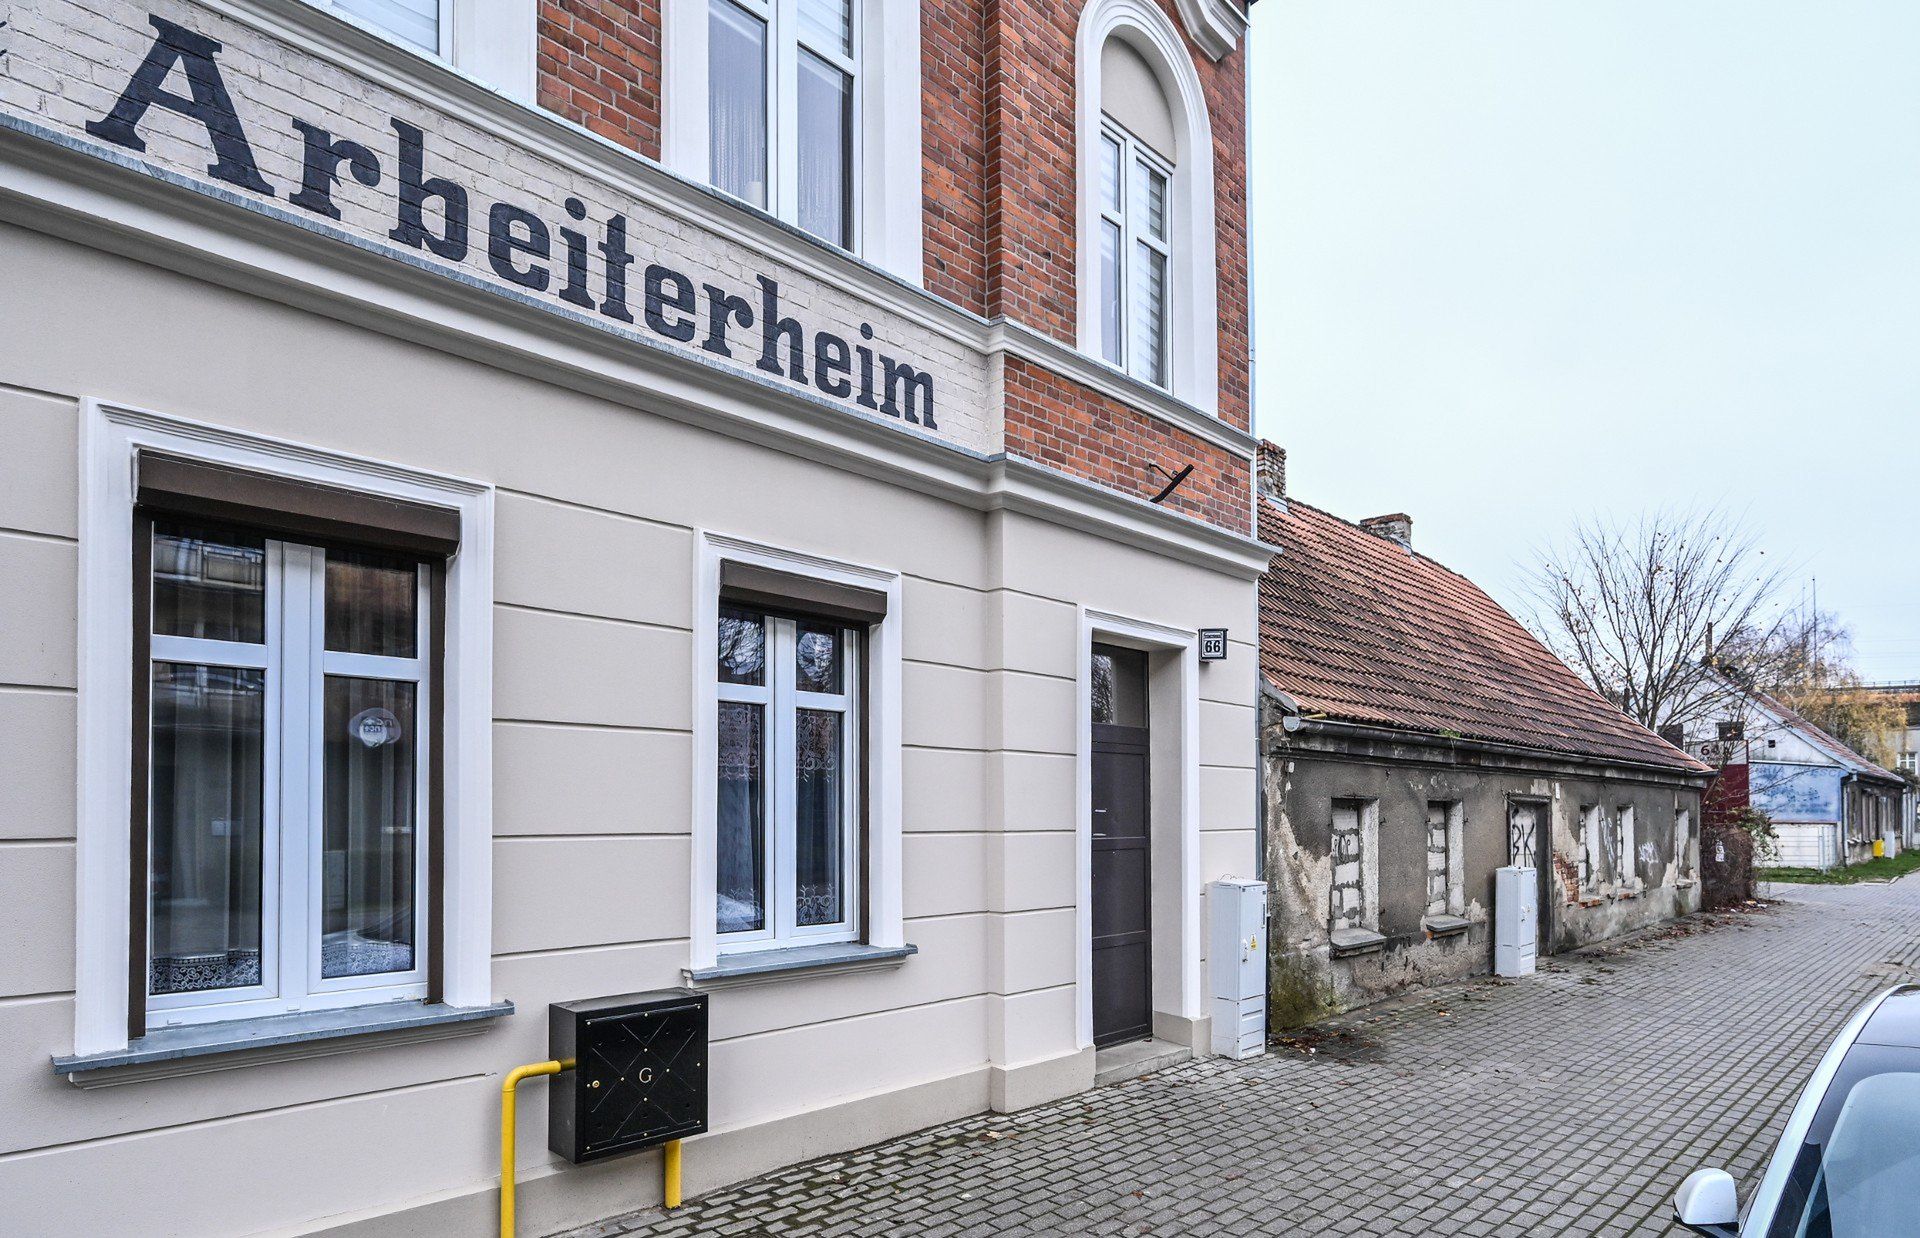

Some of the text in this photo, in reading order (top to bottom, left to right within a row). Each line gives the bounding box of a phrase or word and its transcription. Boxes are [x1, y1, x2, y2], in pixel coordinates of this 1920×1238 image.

[86, 13, 938, 430] Arbeiterheim
[1205, 640, 1221, 653] 66
[638, 1067, 653, 1084] G
